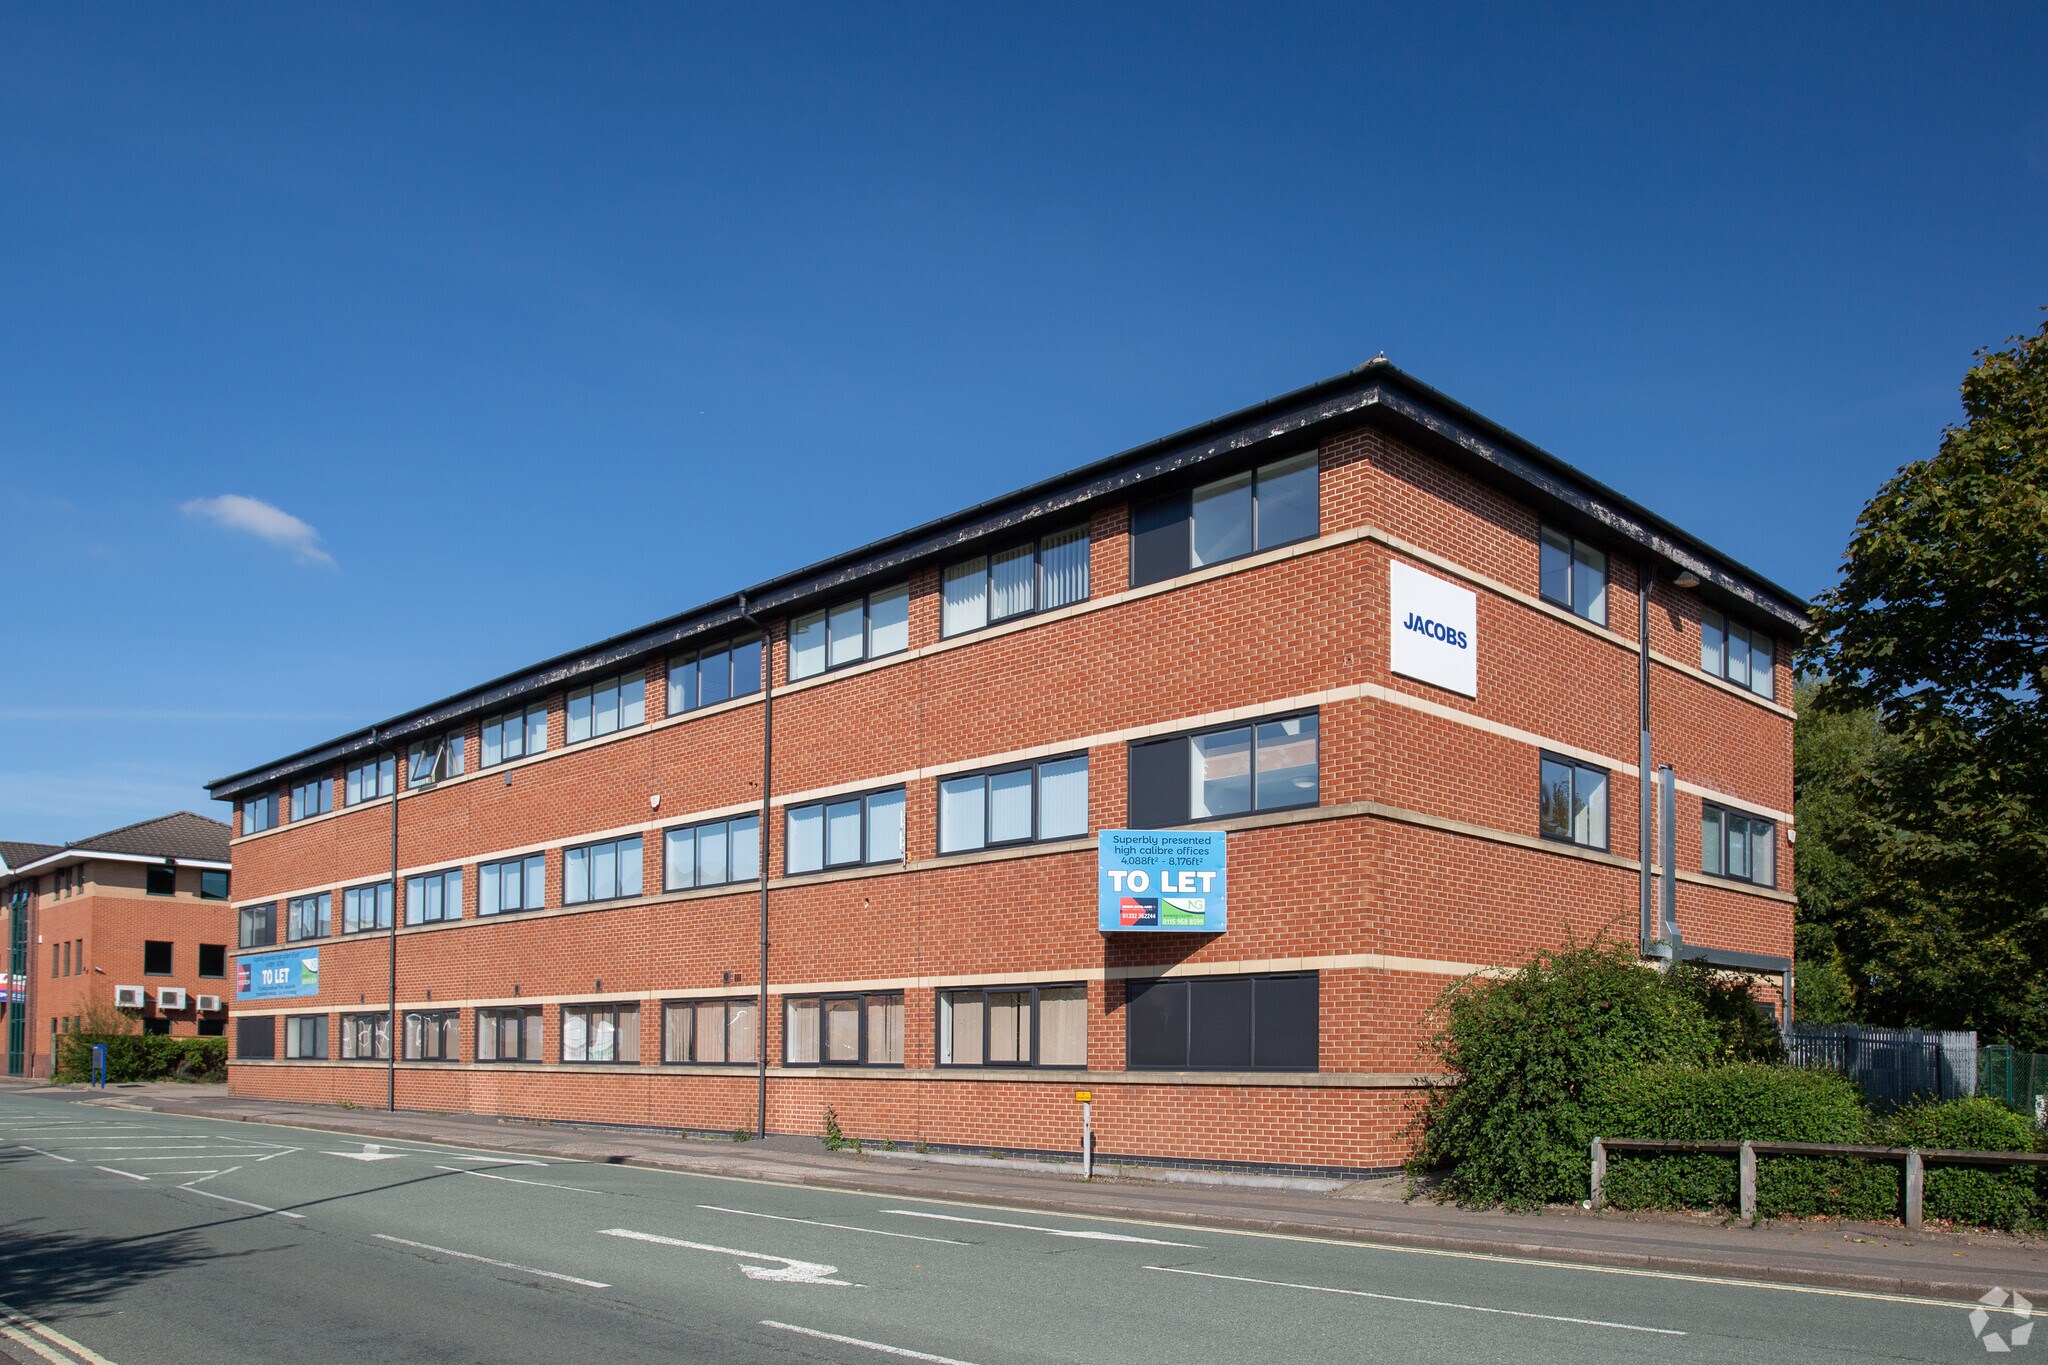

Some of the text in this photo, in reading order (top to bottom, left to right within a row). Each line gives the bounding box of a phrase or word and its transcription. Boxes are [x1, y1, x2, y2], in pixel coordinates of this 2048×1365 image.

[1403, 612, 1468, 650] JACOBS
[1113, 835, 1211, 846] Superbly presented
[1114, 846, 1210, 856] high calibre offices
[1107, 869, 1217, 893] TO LET
[1188, 899, 1203, 910] NG
[262, 969, 273, 985] TO
[274, 967, 290, 984] LET
